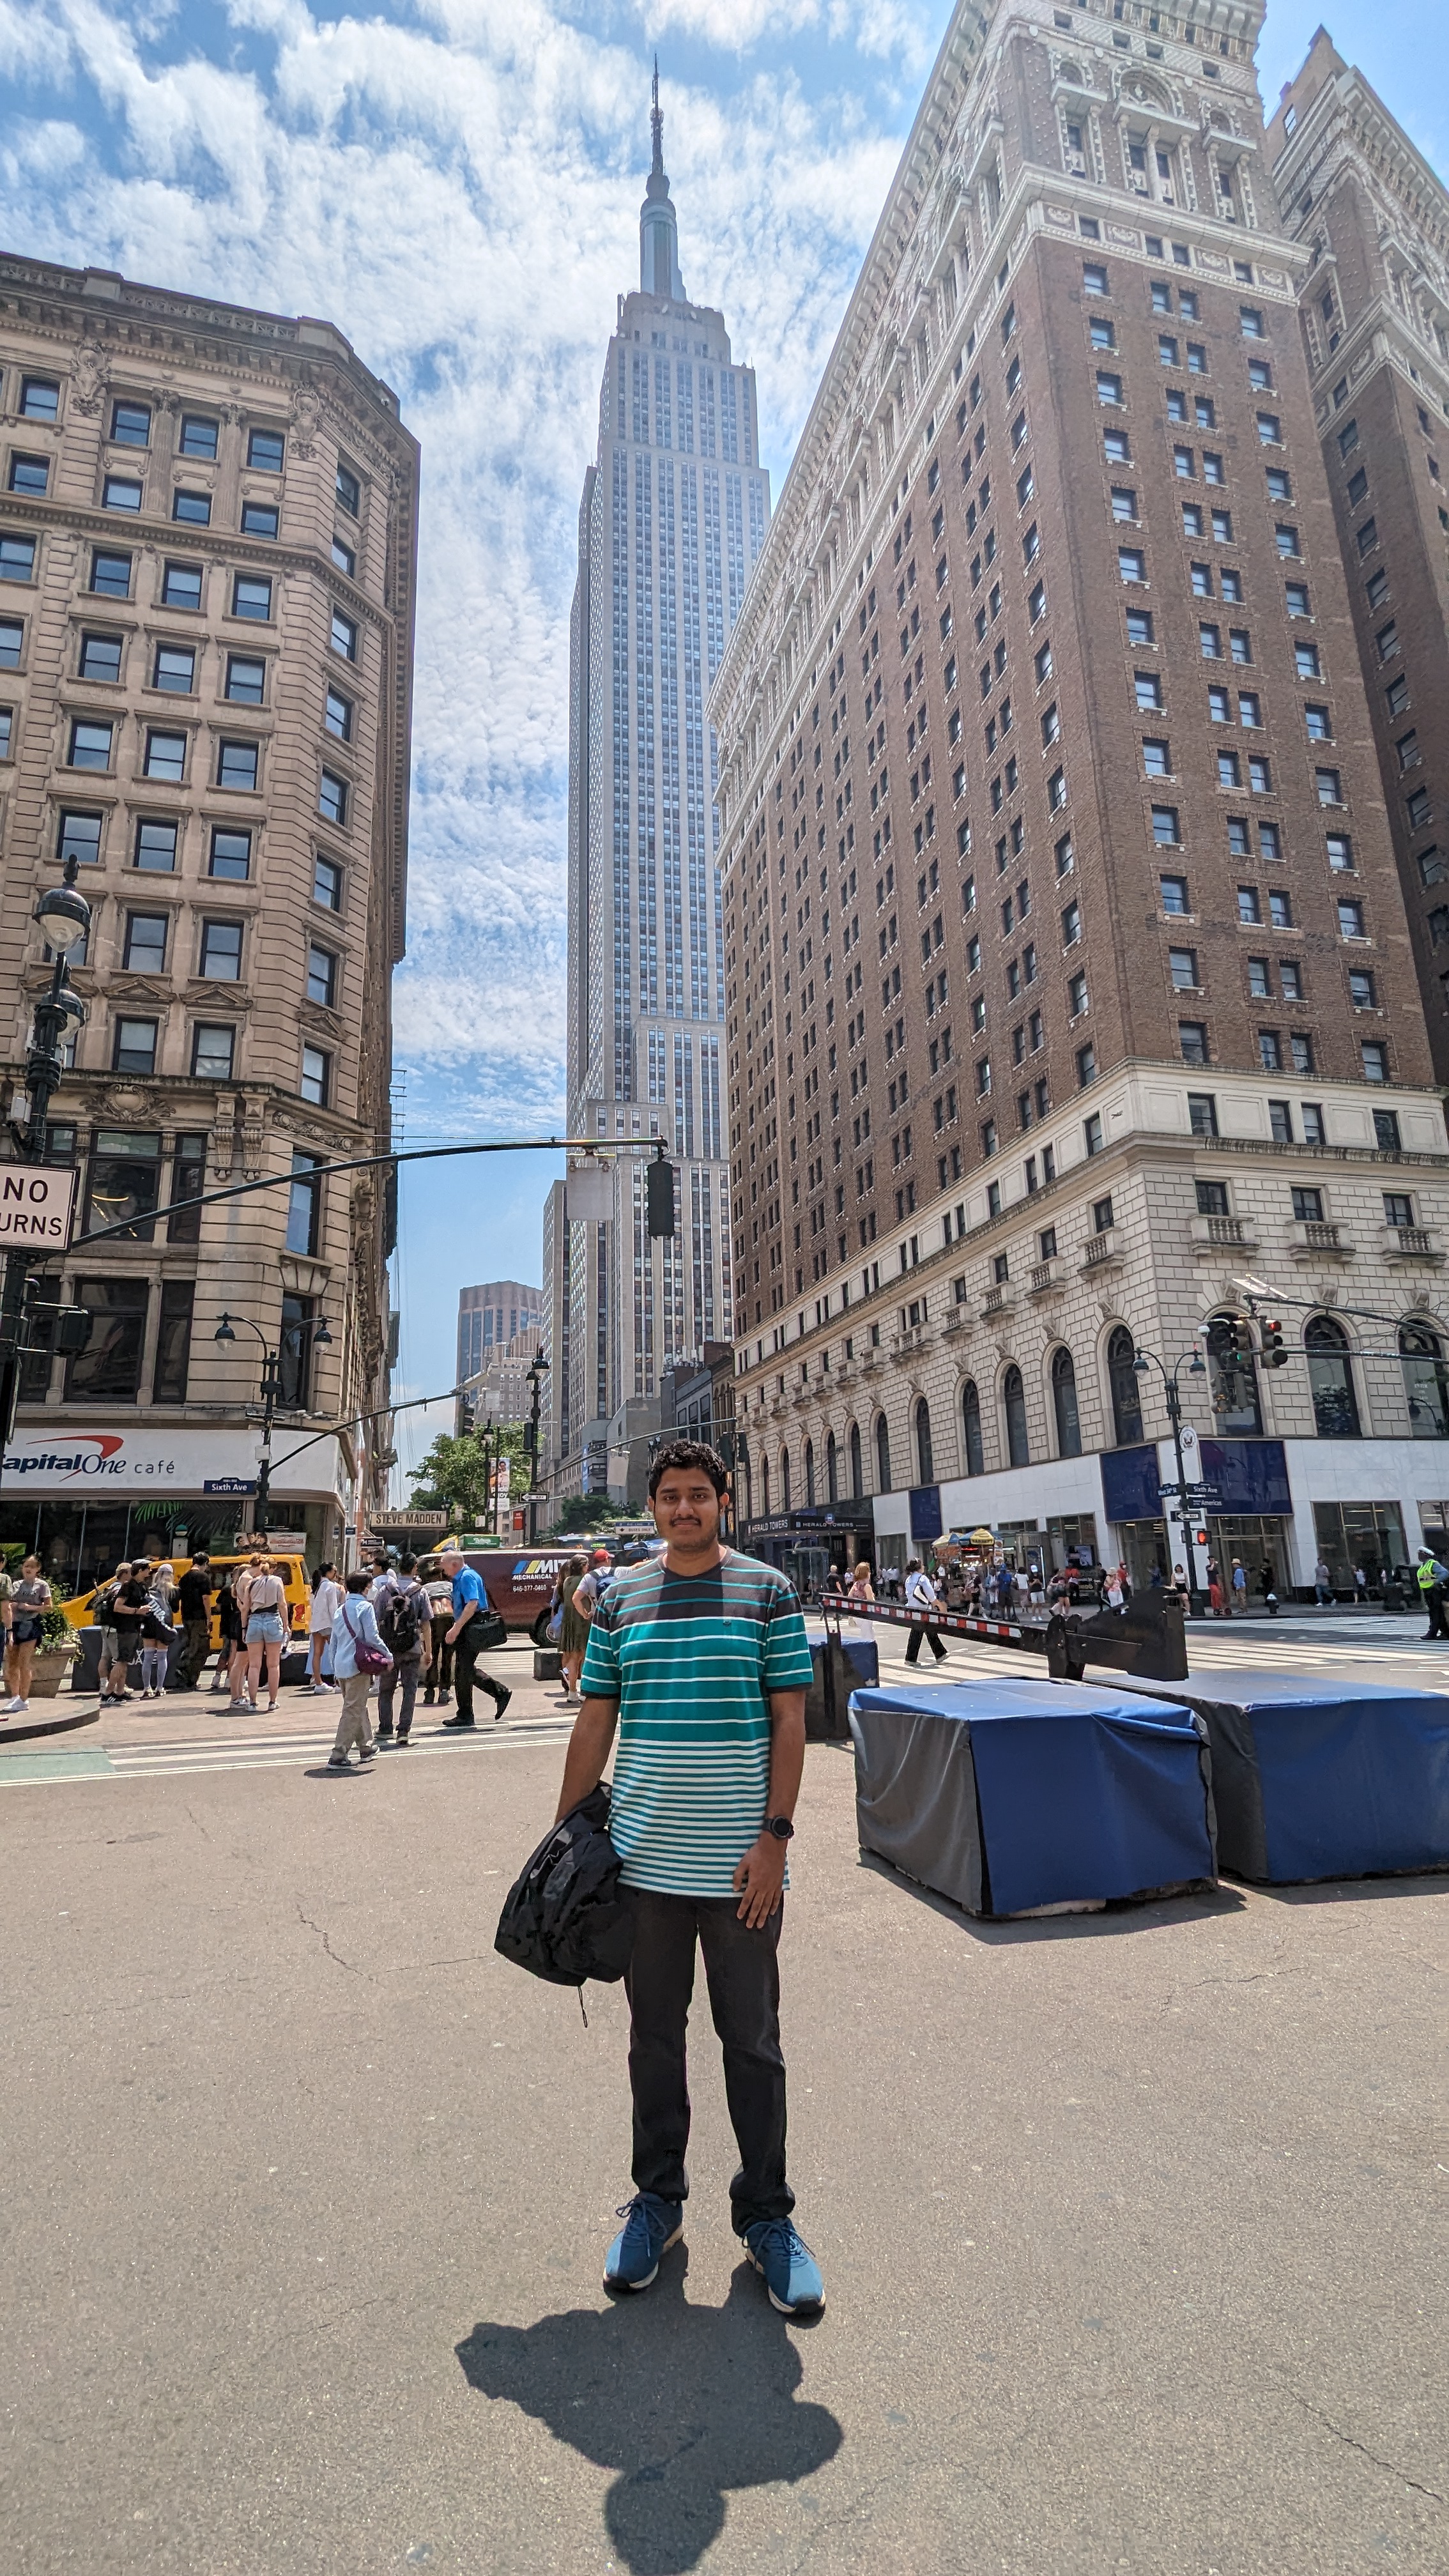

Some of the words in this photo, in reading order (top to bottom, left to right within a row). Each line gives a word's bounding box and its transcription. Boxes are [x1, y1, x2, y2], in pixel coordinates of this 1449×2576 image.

[3, 1176, 49, 1203] NO
[0, 1212, 62, 1236] URNS
[134, 1460, 175, 1474] café
[211, 1483, 231, 1491] Sixth
[376, 1514, 402, 1524] STEVE
[406, 1514, 441, 1524] MADDEN
[751, 1521, 769, 1533] HERALD
[769, 1519, 788, 1531] TOWERS
